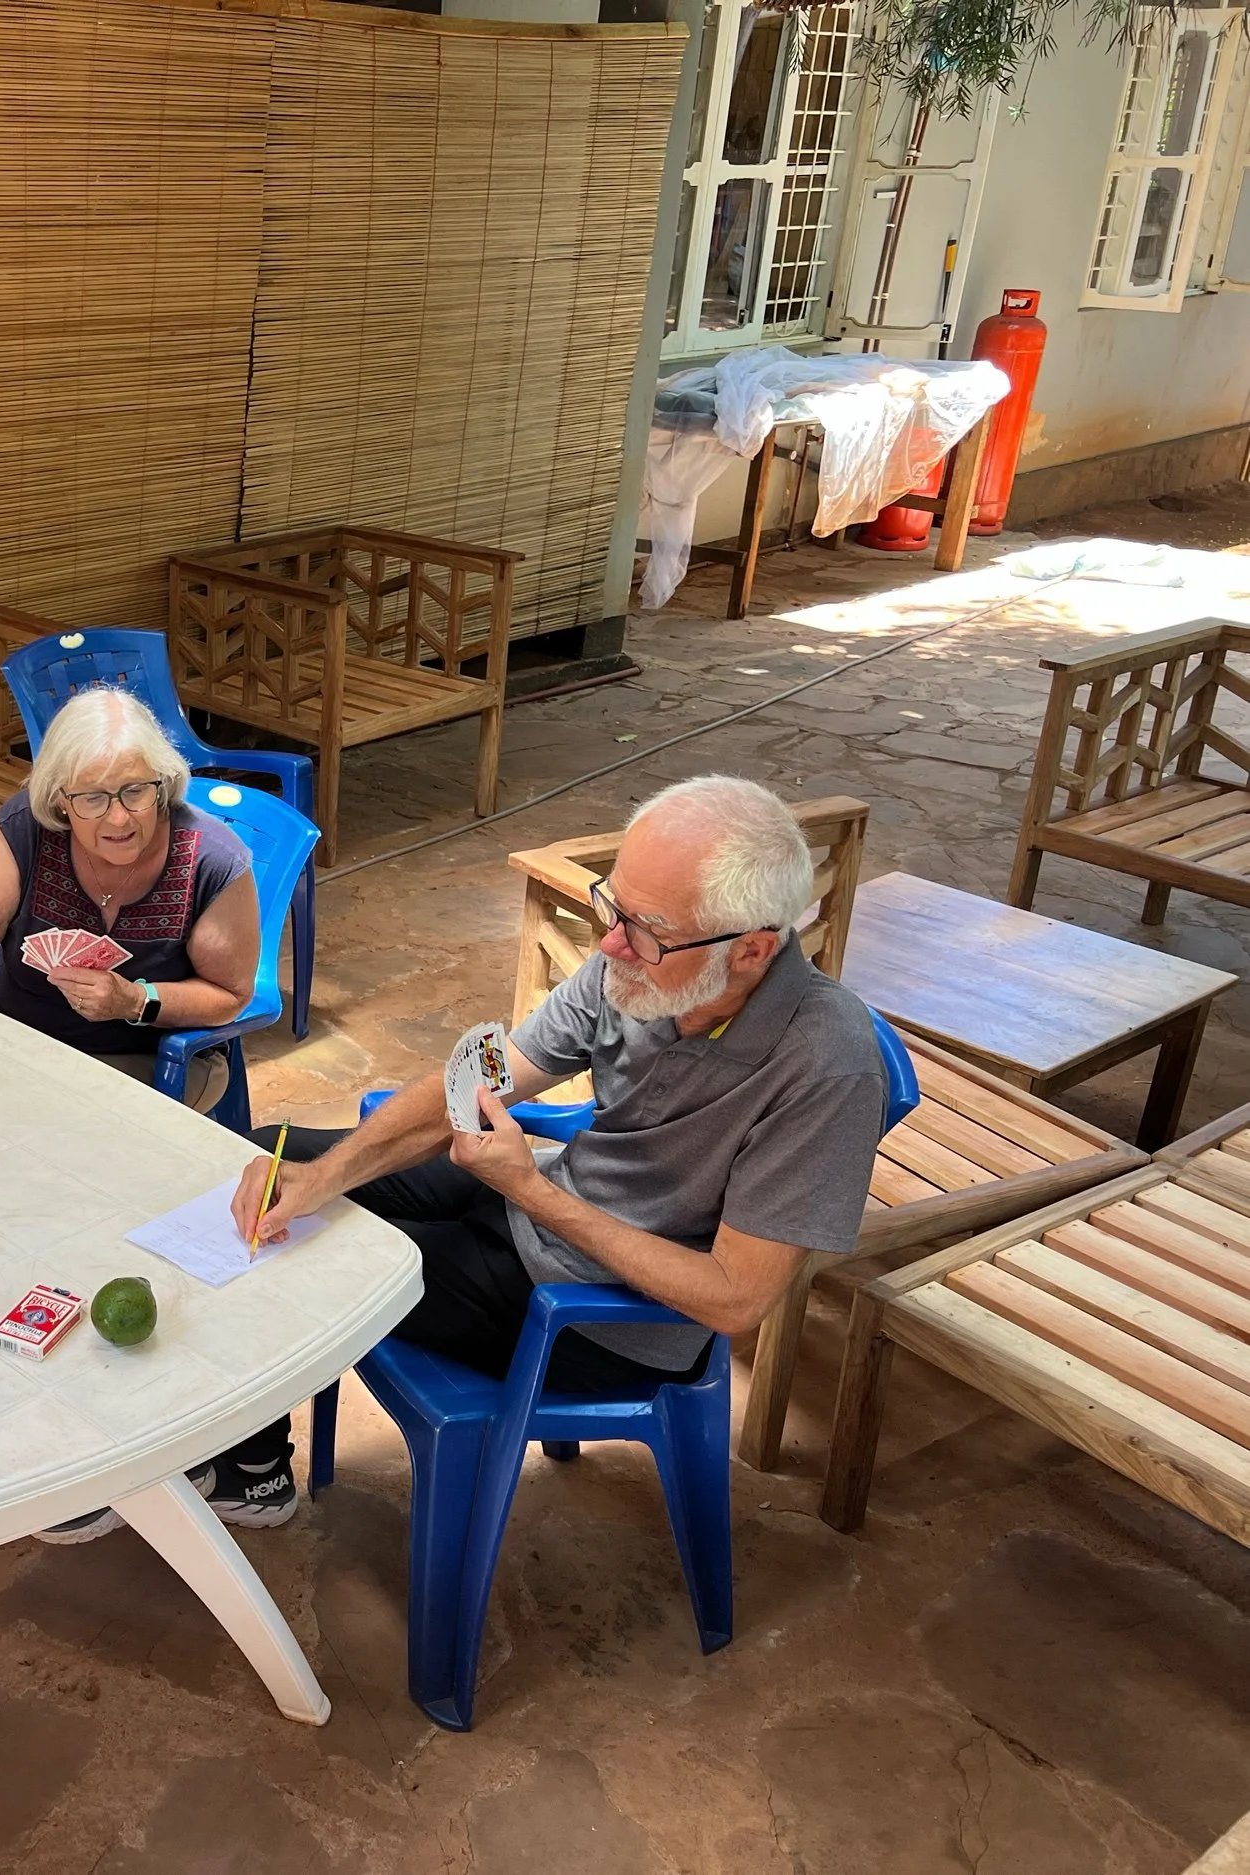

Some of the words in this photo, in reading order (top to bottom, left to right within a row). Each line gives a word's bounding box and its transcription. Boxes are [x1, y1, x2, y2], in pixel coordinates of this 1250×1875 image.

[26, 1295, 68, 1318] BICYCLE
[5, 1320, 44, 1336] PINOCHLE
[245, 1474, 289, 1500] HOKA
